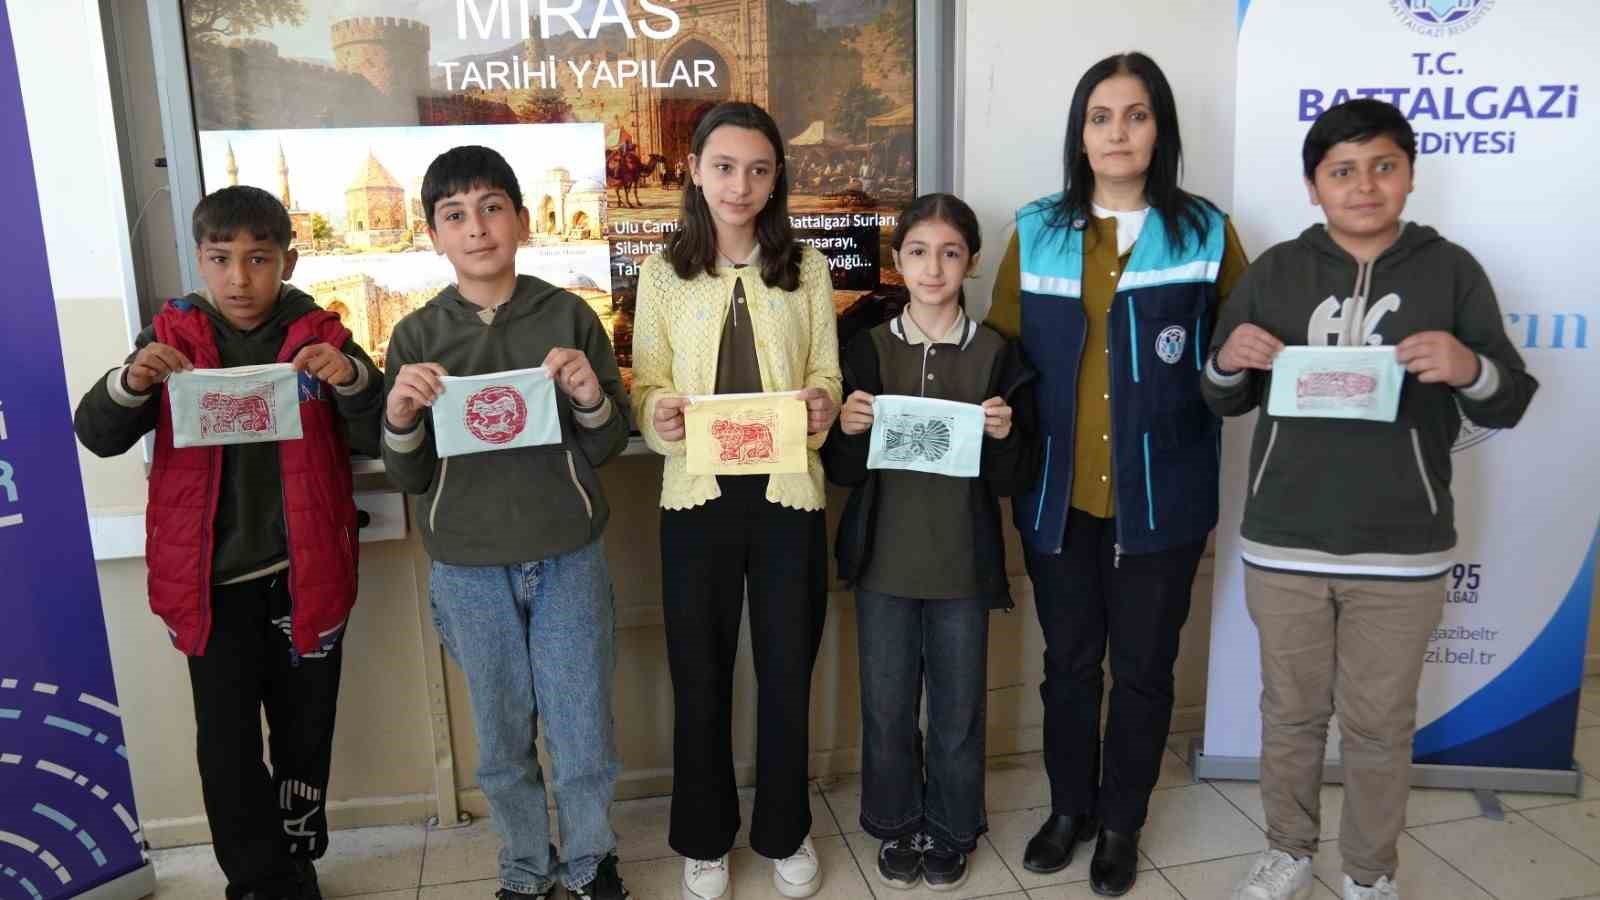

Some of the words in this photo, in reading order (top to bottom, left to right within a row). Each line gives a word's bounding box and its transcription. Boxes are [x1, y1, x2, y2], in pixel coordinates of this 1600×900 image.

[437, 55, 557, 91] TARİHİ
[567, 59, 718, 89] YAPILAR
[1412, 52, 1463, 75] T.C.
[614, 220, 639, 235] Ulu
[827, 254, 872, 270] yüğü...
[1451, 563, 1482, 590] 95
[1423, 647, 1497, 665] zi.bel.tr
